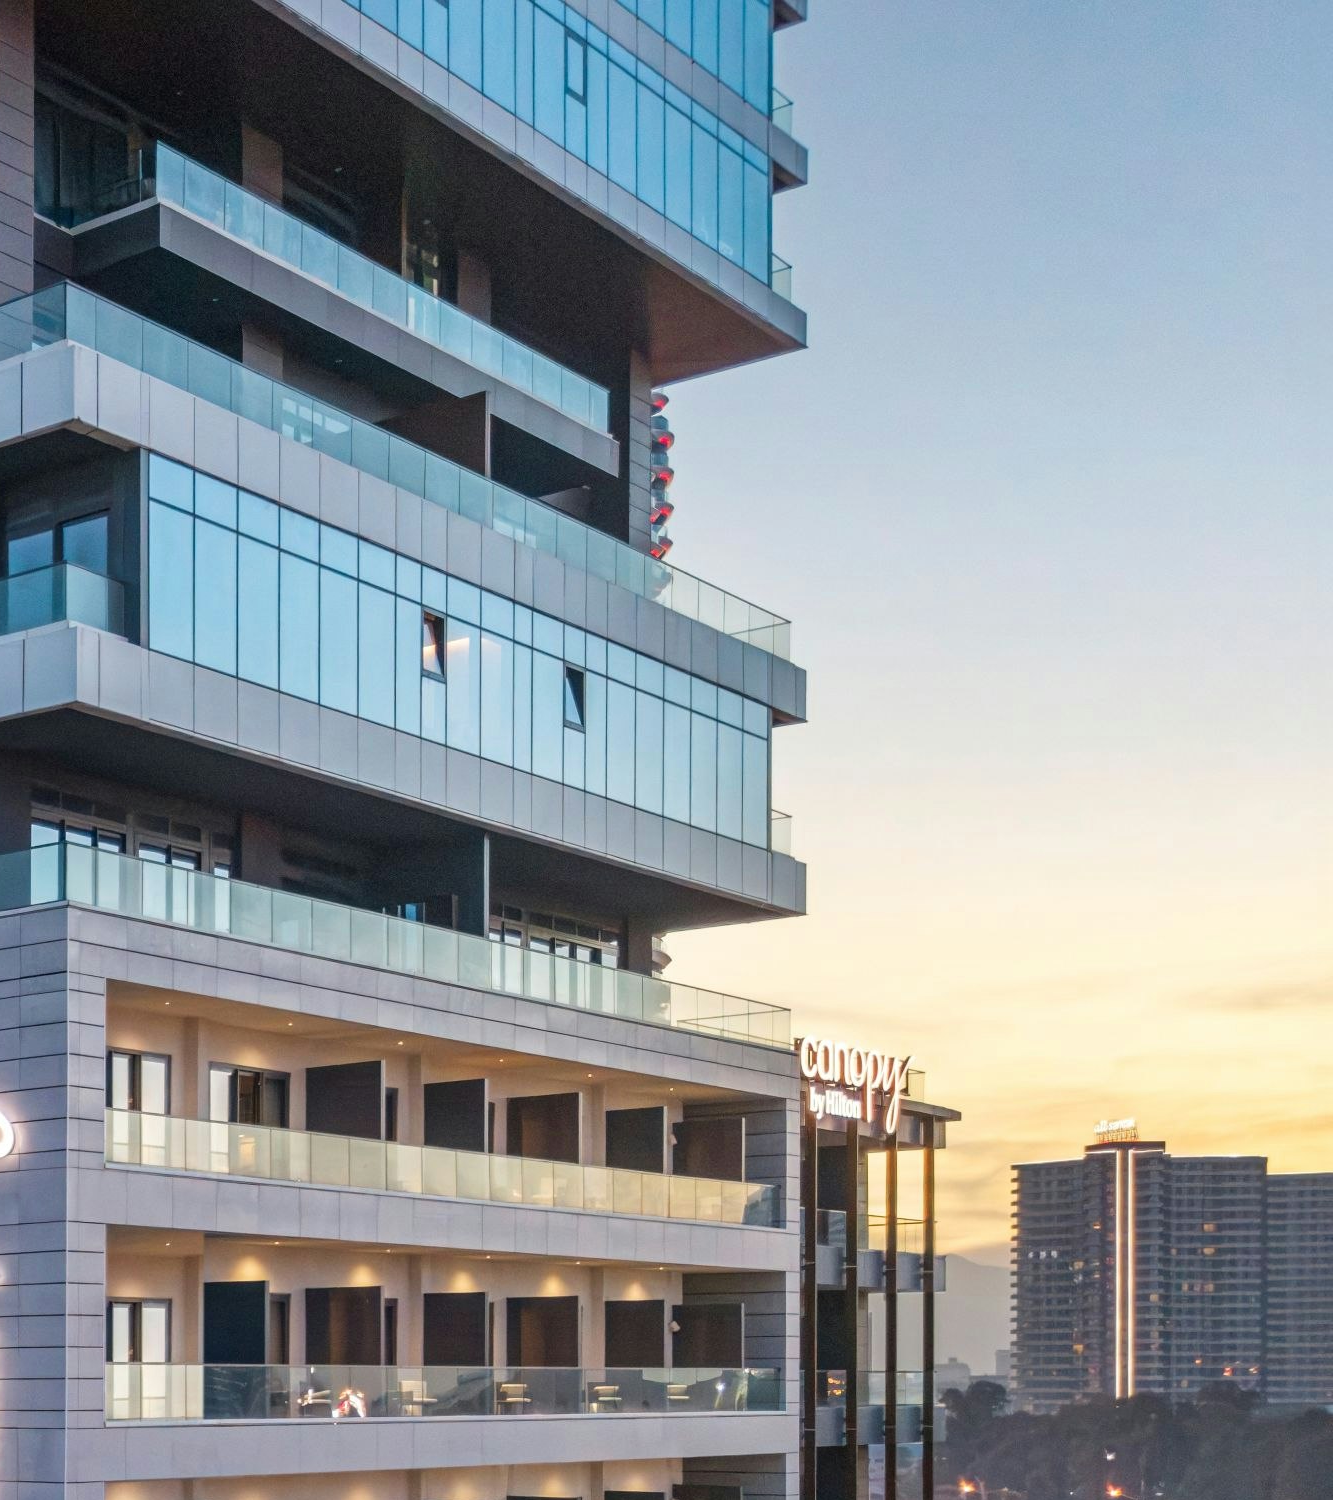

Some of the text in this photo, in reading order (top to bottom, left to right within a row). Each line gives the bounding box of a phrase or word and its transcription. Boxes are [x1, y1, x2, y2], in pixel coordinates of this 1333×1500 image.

[800, 1034, 916, 1135] canopy
[809, 1086, 863, 1120] by Hilton
